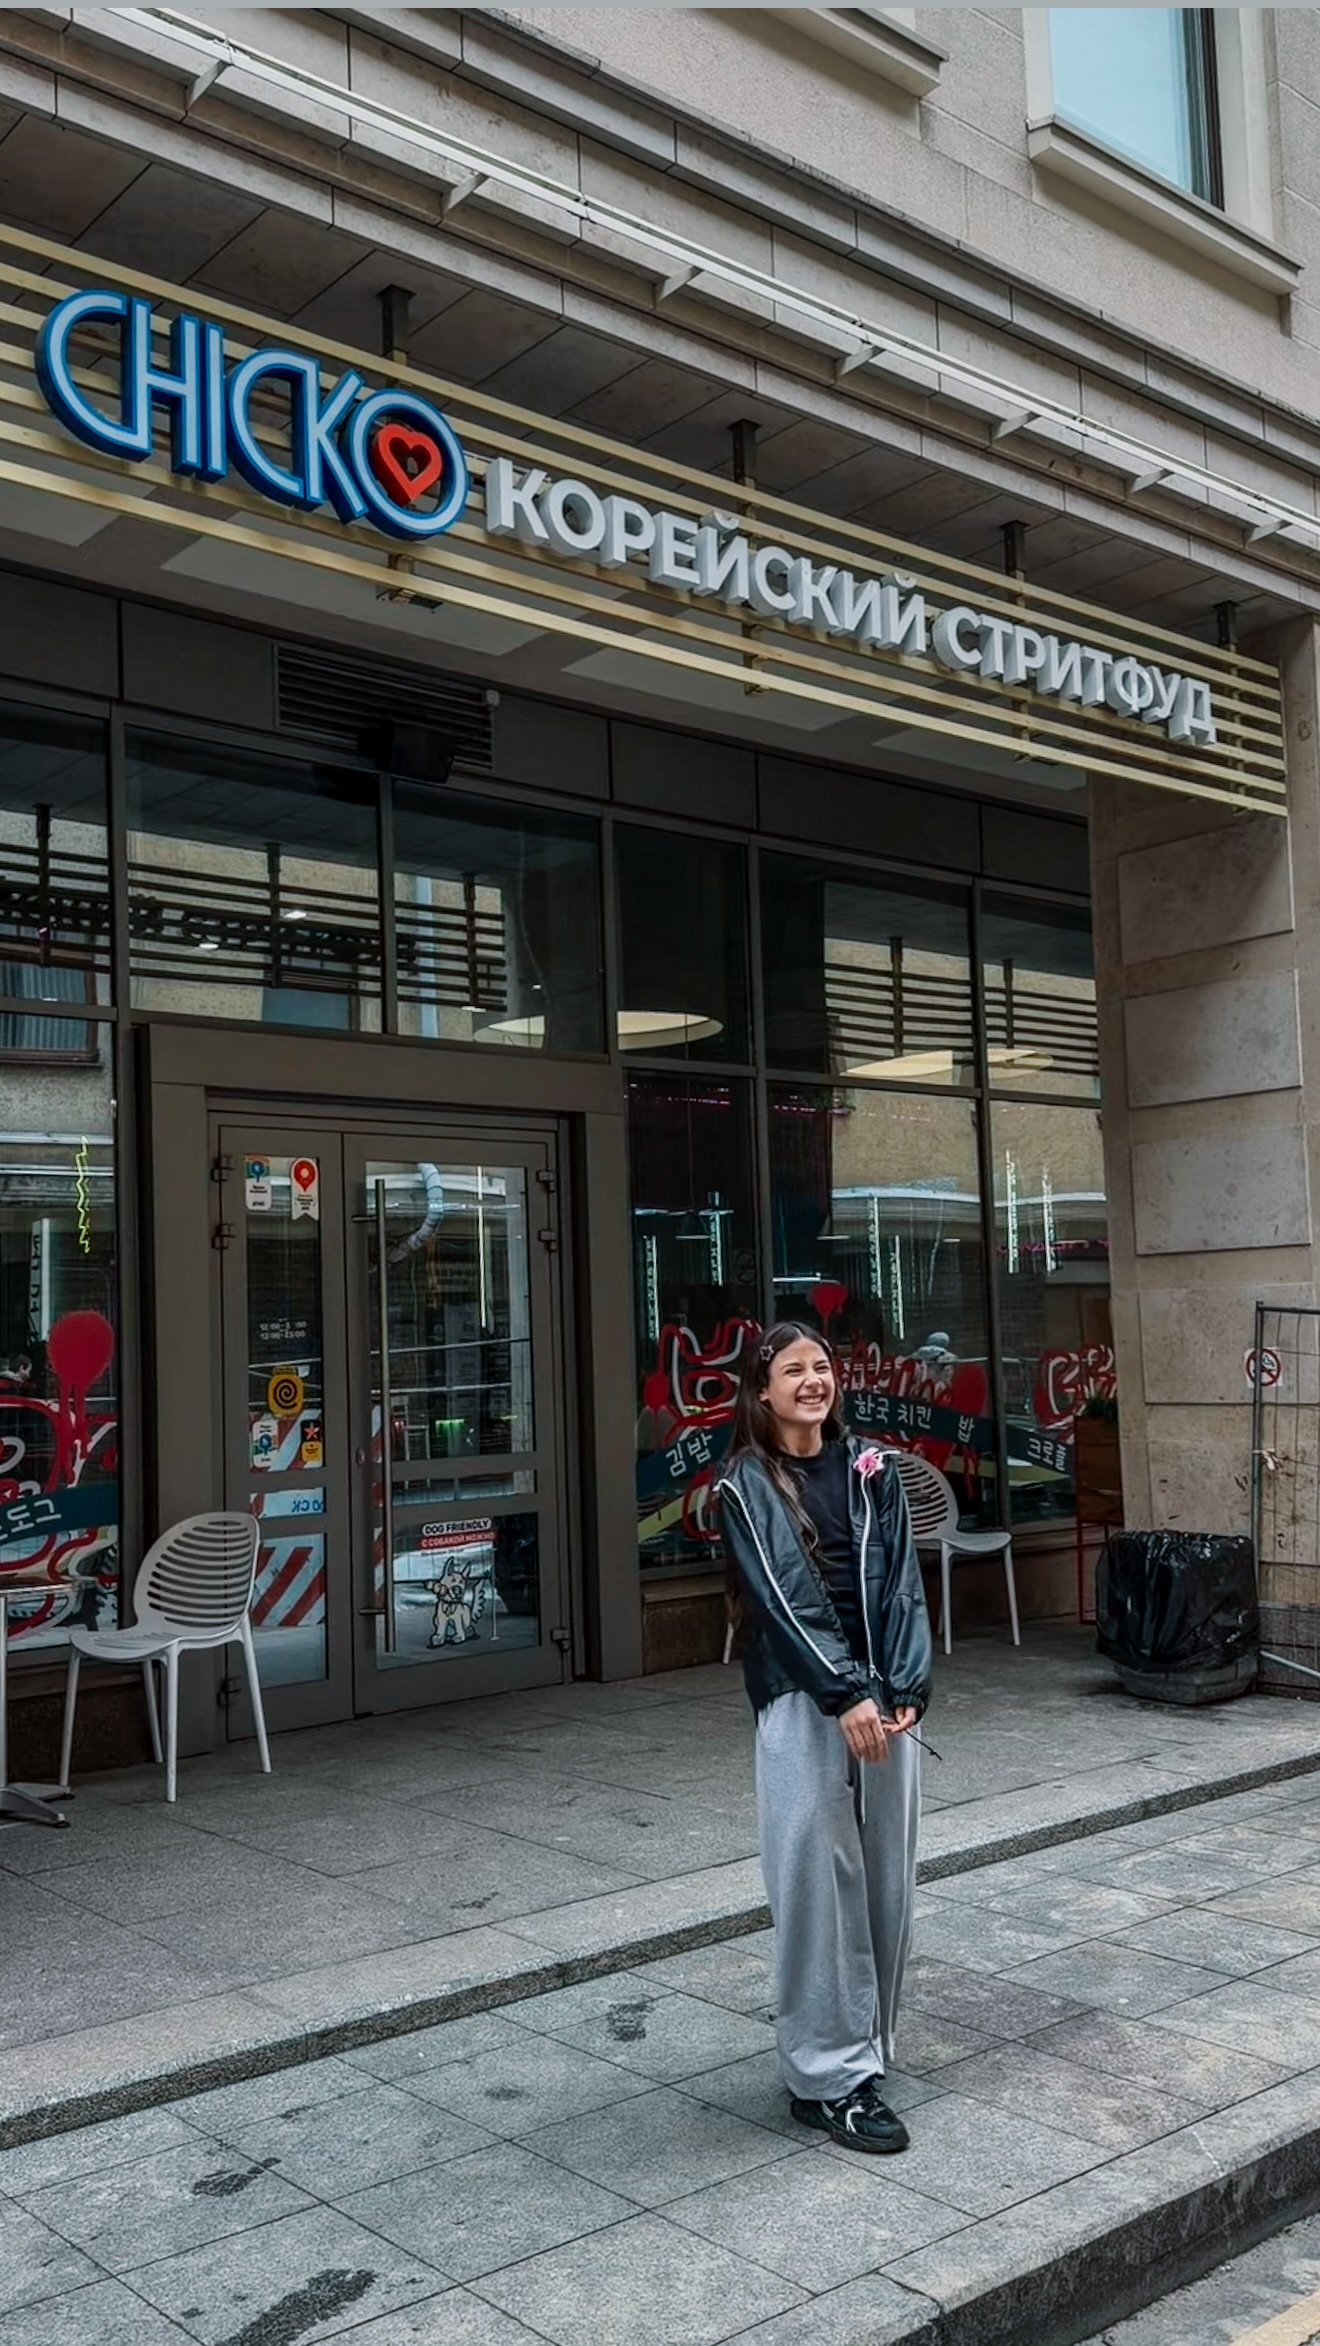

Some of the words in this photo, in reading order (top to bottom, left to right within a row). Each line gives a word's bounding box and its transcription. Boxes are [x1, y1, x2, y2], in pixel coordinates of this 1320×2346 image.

[34, 288, 470, 541] CHICKO
[485, 457, 927, 656] КОРЕЙСКИЙ
[932, 606, 1217, 746] СТРИТФУД
[853, 1392, 891, 1425] 한국
[897, 1403, 932, 1430] 치킨
[957, 1414, 976, 1444] 밥
[665, 1432, 713, 1478] 김밥
[0, 1497, 62, 1542] 도그
[425, 1524, 445, 1534] DOG
[446, 1519, 489, 1532] FRIENDLY
